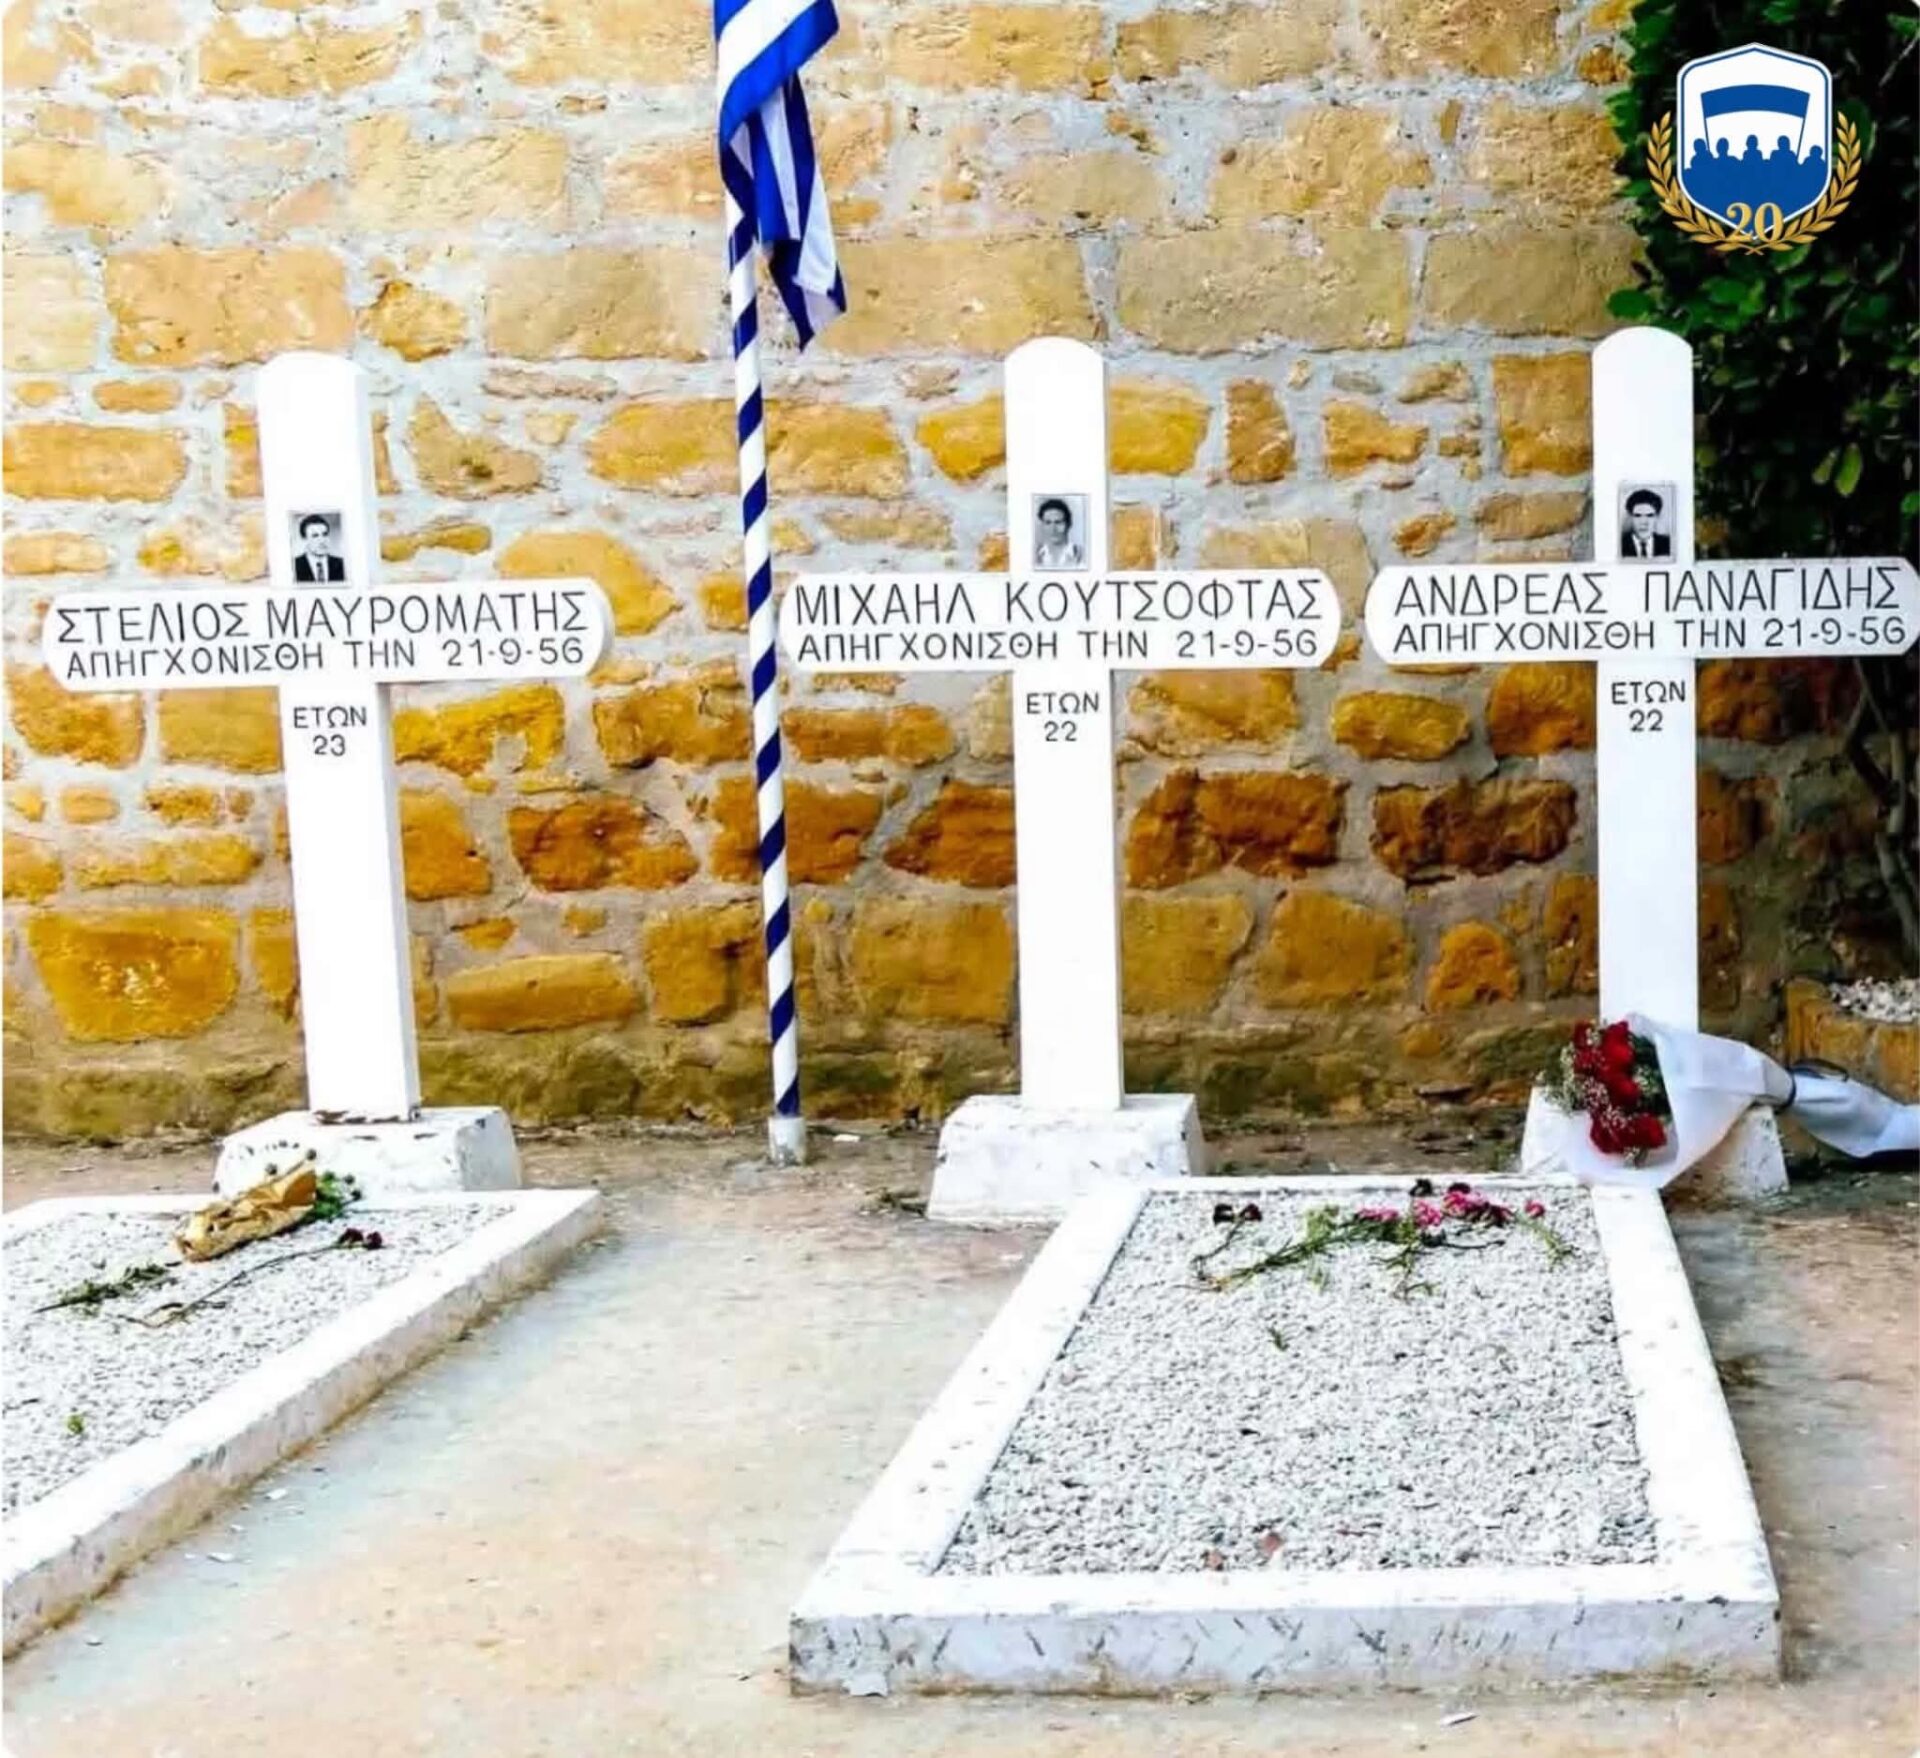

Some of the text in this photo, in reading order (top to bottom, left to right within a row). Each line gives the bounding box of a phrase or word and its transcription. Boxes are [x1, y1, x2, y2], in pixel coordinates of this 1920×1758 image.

[796, 579, 1322, 626] ΜΙΧΑΗΛ ΚΟΥΤΣΟΦΤΑΣ
[1394, 566, 1901, 617] ΑΝΔΡΕΑΣ ΠΑΝΑΓΙΔΗΣ
[57, 591, 588, 643] ΣΤΕΛΙΟΣ ΜΑΥΡΟΜΑΤΗΣ
[798, 628, 1318, 663] ΑΠΗΓΧΟΝΙΣΘΗ ΤΗΝ 21-9-56
[1394, 616, 1906, 654] ΑΠΗΓΧΟΝΙΣΘΗ ΤΗΝ 21-9-56
[66, 637, 584, 679] ΑΠΗΓΧΟΝΙΣΘΗ ΤΗΝ 21-9-56
[1026, 692, 1099, 715] ΕΤΩΝ
[1611, 680, 1686, 704] ΕΤΩΝ
[293, 706, 368, 729] ΕΤΩΝ
[1043, 720, 1078, 743] 22
[1629, 709, 1663, 732] 22
[312, 734, 346, 757] 23
